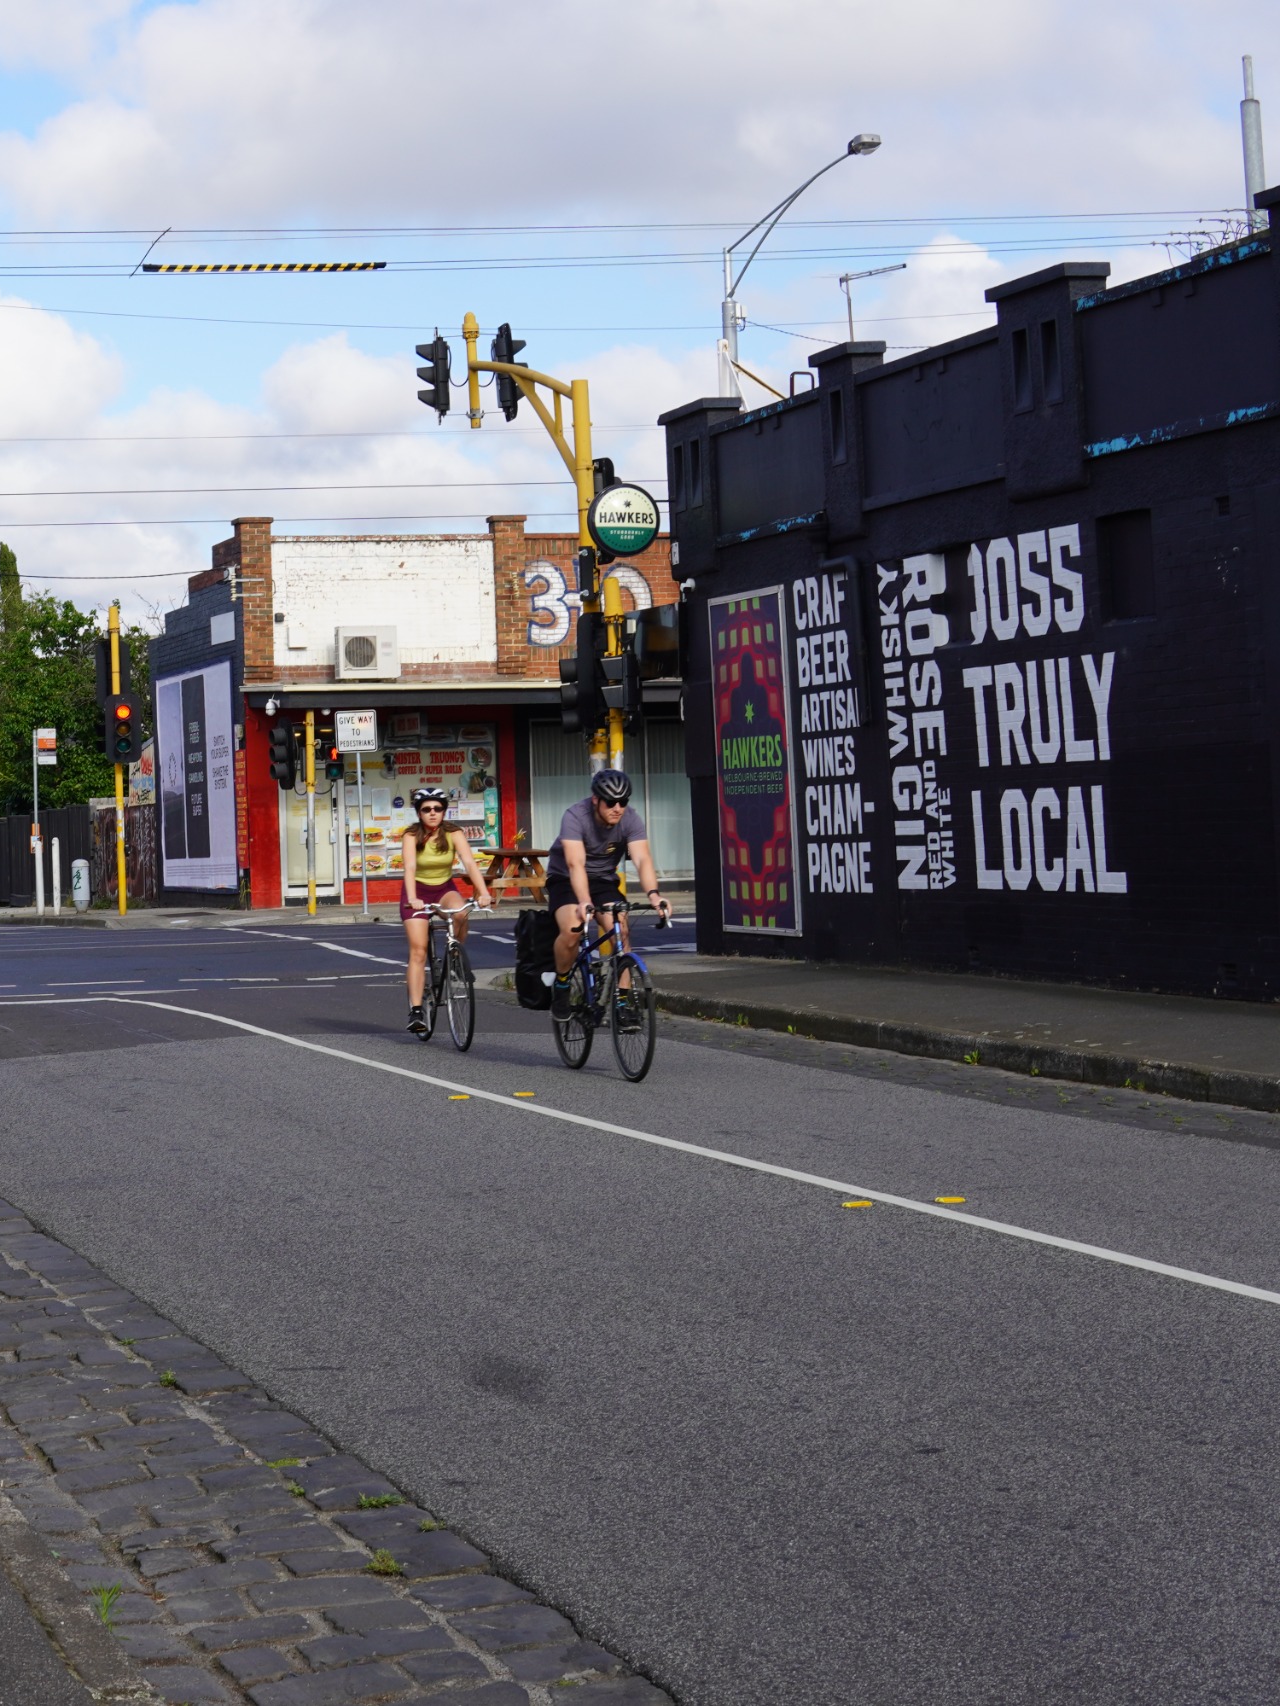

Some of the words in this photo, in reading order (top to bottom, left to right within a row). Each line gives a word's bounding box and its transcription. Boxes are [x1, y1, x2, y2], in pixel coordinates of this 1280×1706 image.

[599, 512, 654, 524] HAWKERS
[793, 571, 849, 631] CRAF
[796, 629, 852, 688] BEER
[876, 563, 909, 759] WHISKY
[902, 553, 949, 758] ROSE
[339, 717, 355, 725] GIVE
[358, 715, 373, 724] WAY
[352, 728, 361, 736] TO
[962, 651, 1115, 767] TRULY
[339, 739, 375, 747] PEDESTRIANS
[395, 752, 421, 764] MISTER
[430, 751, 465, 763] TRUONG'S
[722, 734, 783, 769] HAWKERS
[801, 735, 856, 778] WINES
[724, 784, 766, 795] INDEPENDENT
[767, 783, 784, 794] BEER
[805, 782, 875, 836] CHAM-
[922, 760, 939, 820] AND
[892, 765, 929, 890] GIN
[937, 787, 957, 889] WHITE
[971, 785, 1127, 893] LOCAL
[807, 841, 873, 894] PAGNE
[927, 831, 943, 890] RED
